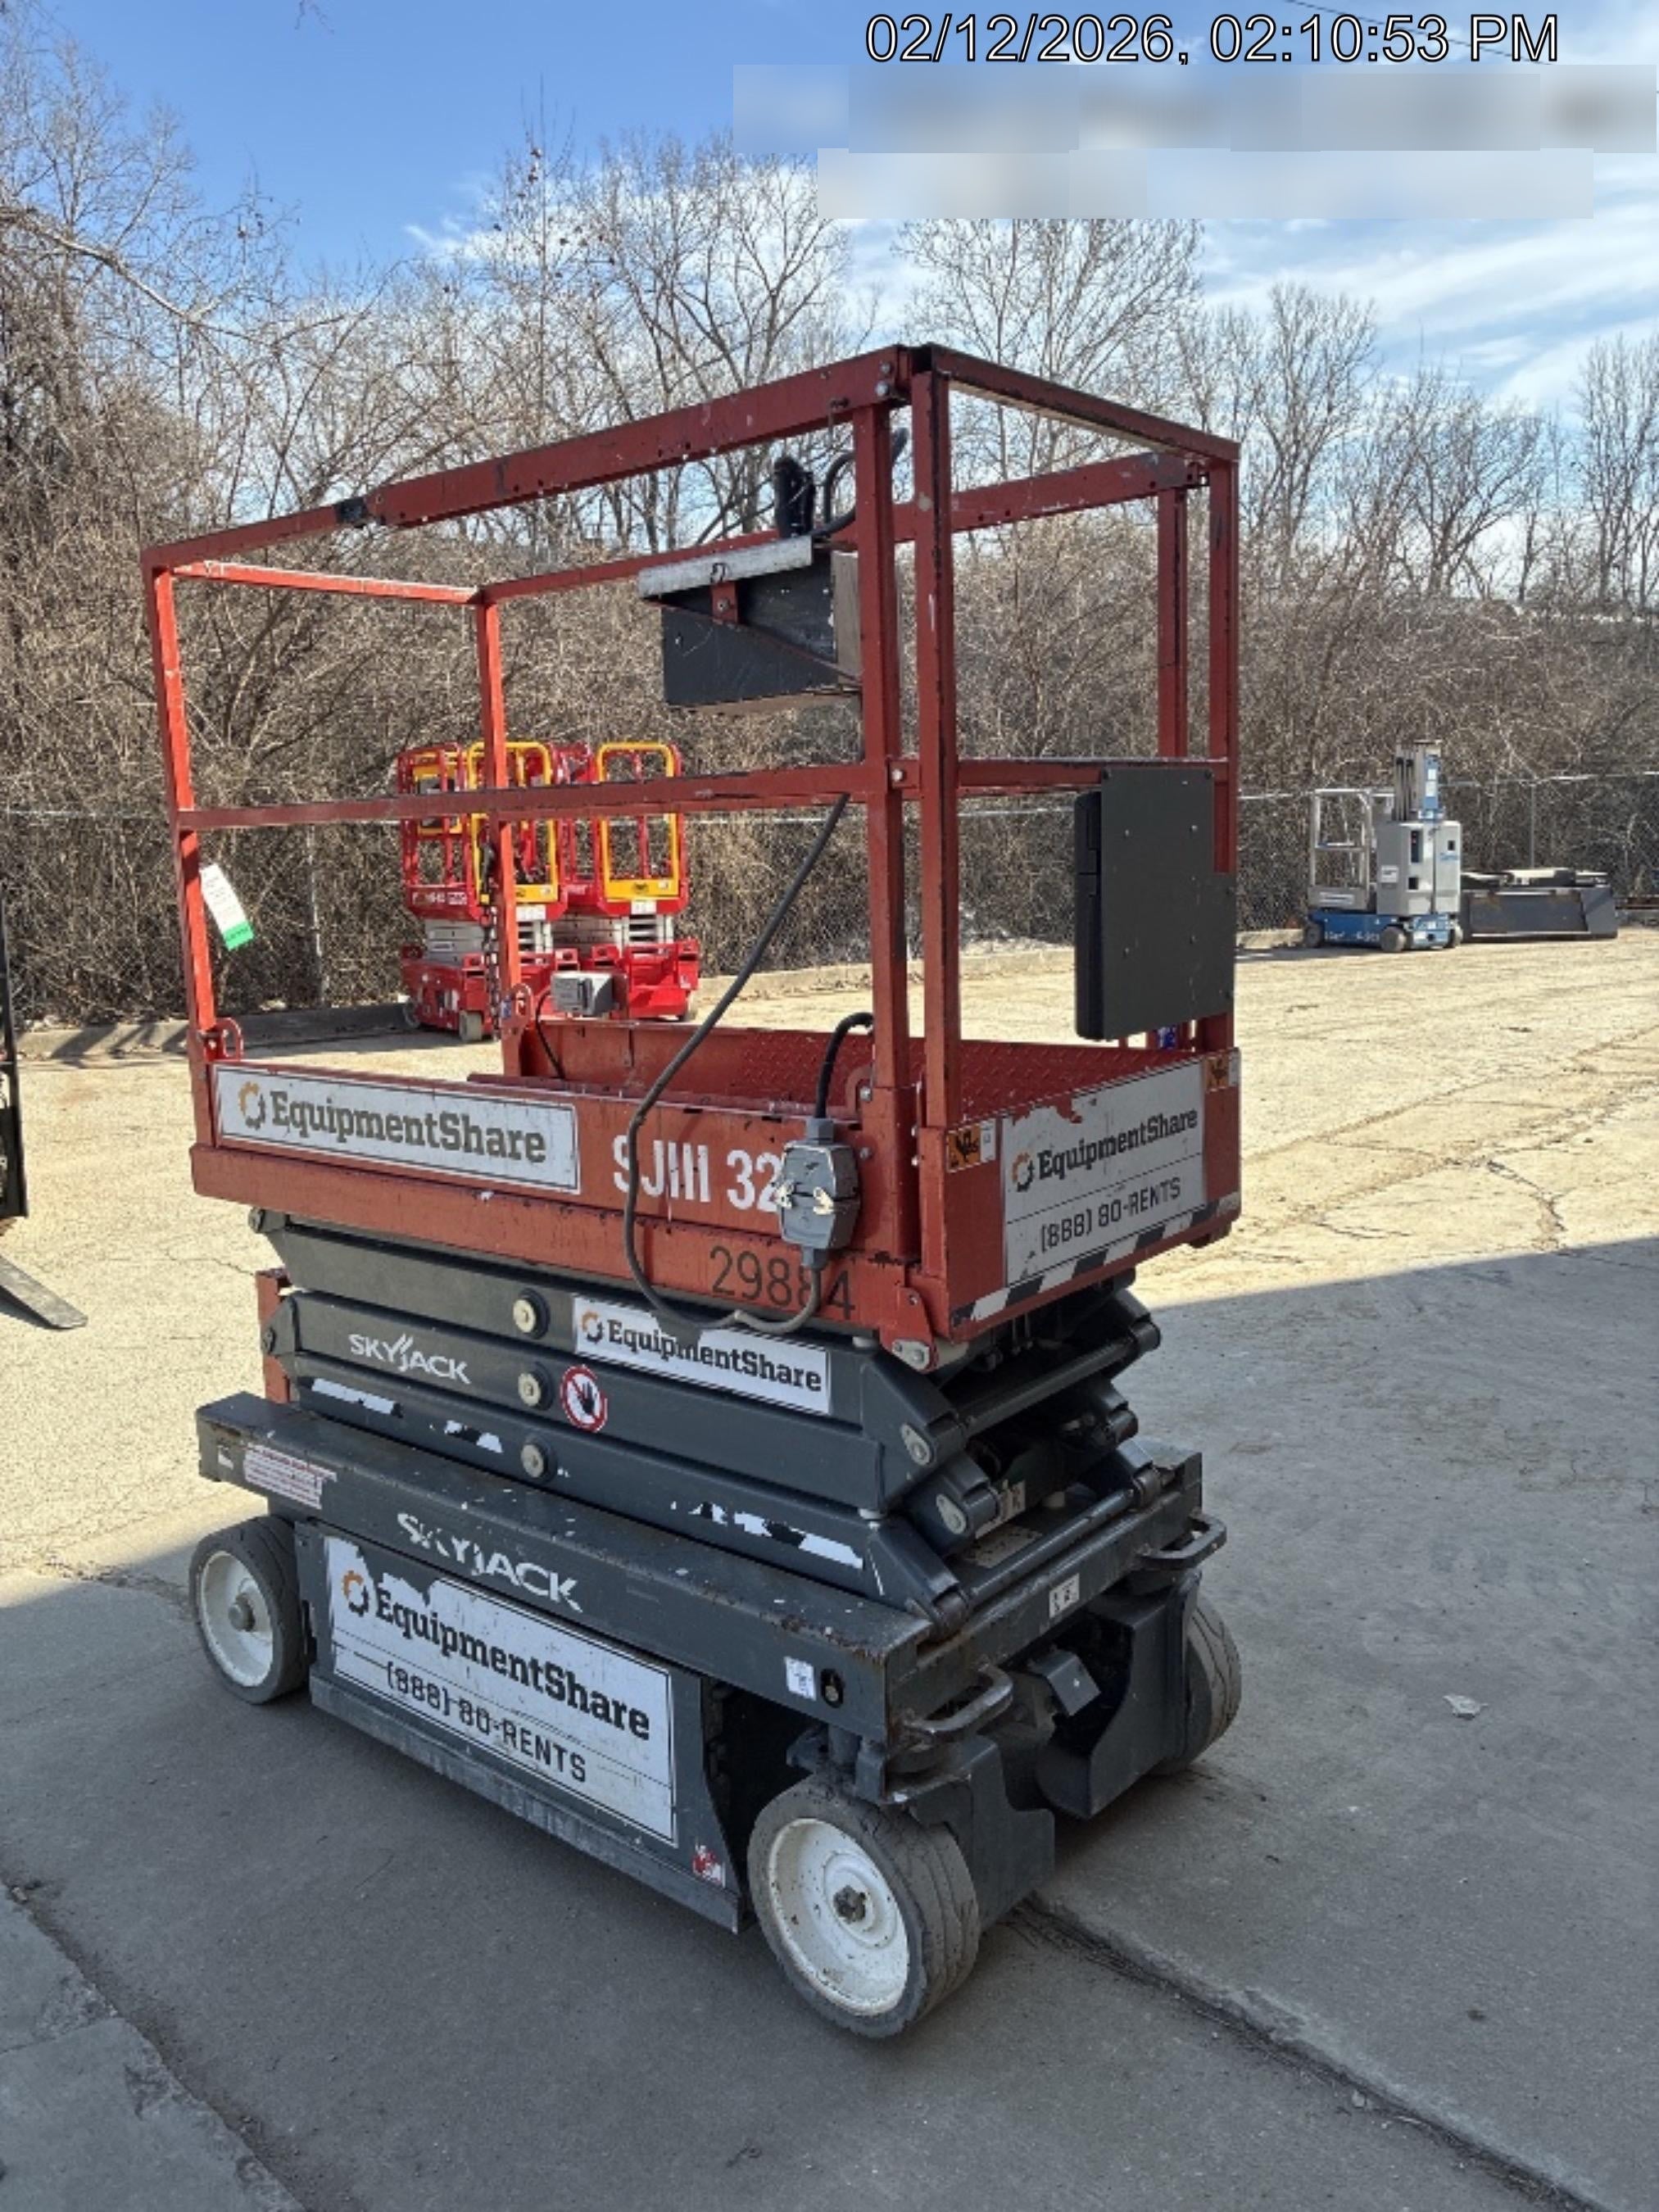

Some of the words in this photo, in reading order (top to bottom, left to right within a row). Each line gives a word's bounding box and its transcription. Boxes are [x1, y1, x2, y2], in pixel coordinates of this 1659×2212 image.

[270, 1090, 546, 1163] EquipmentShare
[1037, 1107, 1198, 1181] EquipmentShare
[1040, 1208, 1092, 1253] (888)
[1098, 1176, 1181, 1227] 80-RENTS
[348, 1333, 471, 1385] SKYJACK
[607, 1320, 823, 1392] EquipmentShare
[375, 1583, 650, 1741] EquipmentShare
[387, 1661, 451, 1716] (888)
[457, 1697, 587, 1783] 80-RENTS
